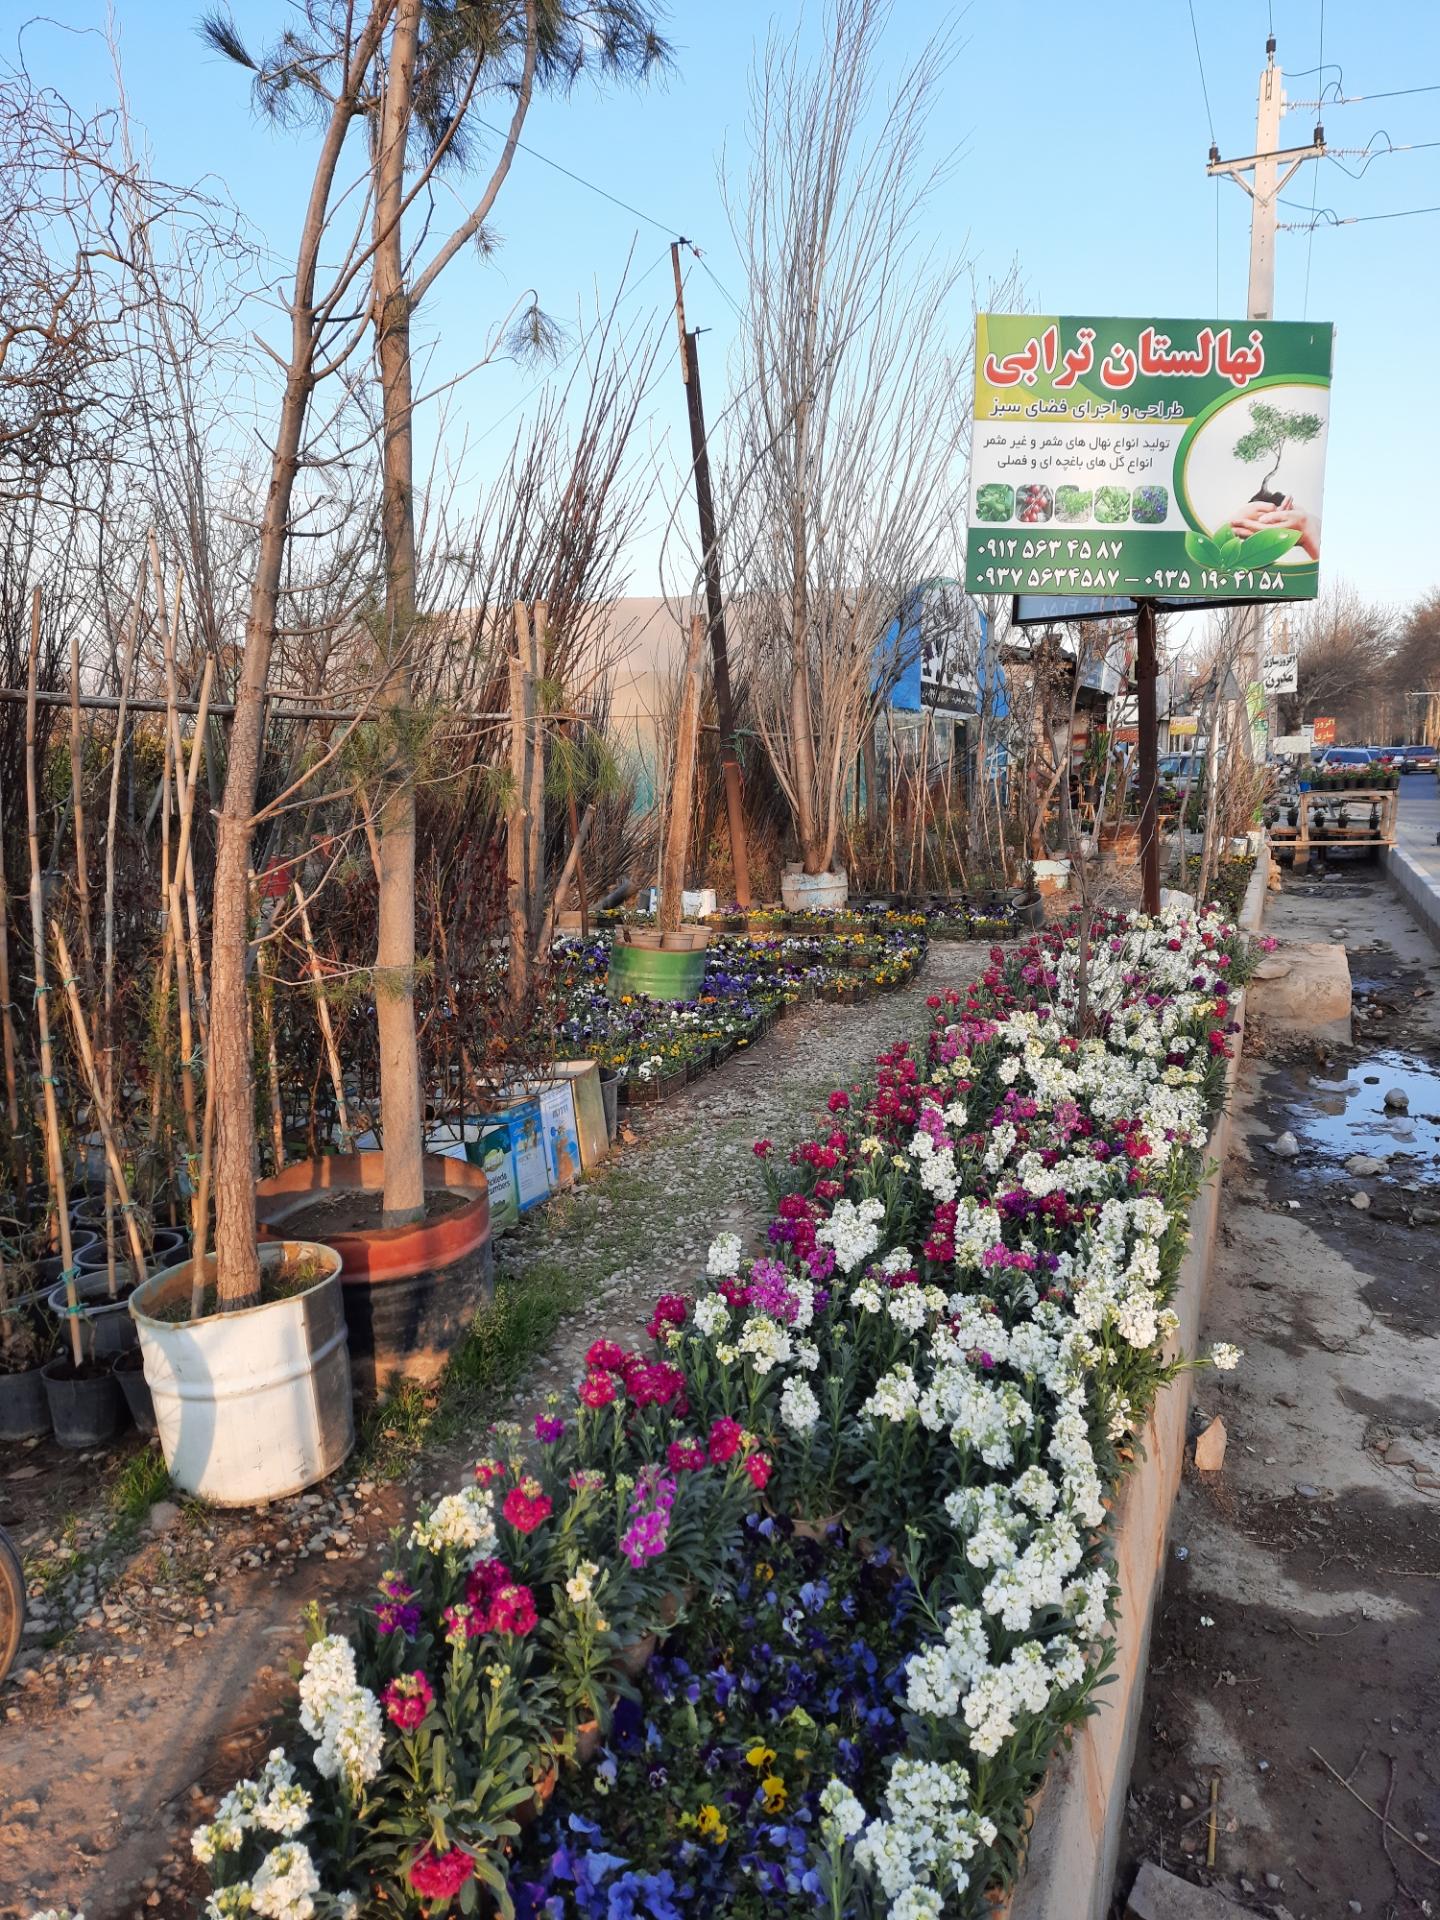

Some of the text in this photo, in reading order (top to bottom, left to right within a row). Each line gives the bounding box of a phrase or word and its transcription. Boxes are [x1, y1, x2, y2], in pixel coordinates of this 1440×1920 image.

[983, 324, 1265, 389] نهالستان ترابی
[990, 398, 1184, 420] طراحی و اجرای فضای سبز
[983, 434, 1170, 454] تولید انواع نهال های مثمر و غیر مثمر
[997, 454, 1153, 474] انواع گل های باغچه ای و فصلی
[977, 538, 1018, 559] ۰۹۱۲
[976, 567, 1023, 587] ۰۹۳۷
[1027, 567, 1120, 588] ۵۶۳۴۵۸۷
